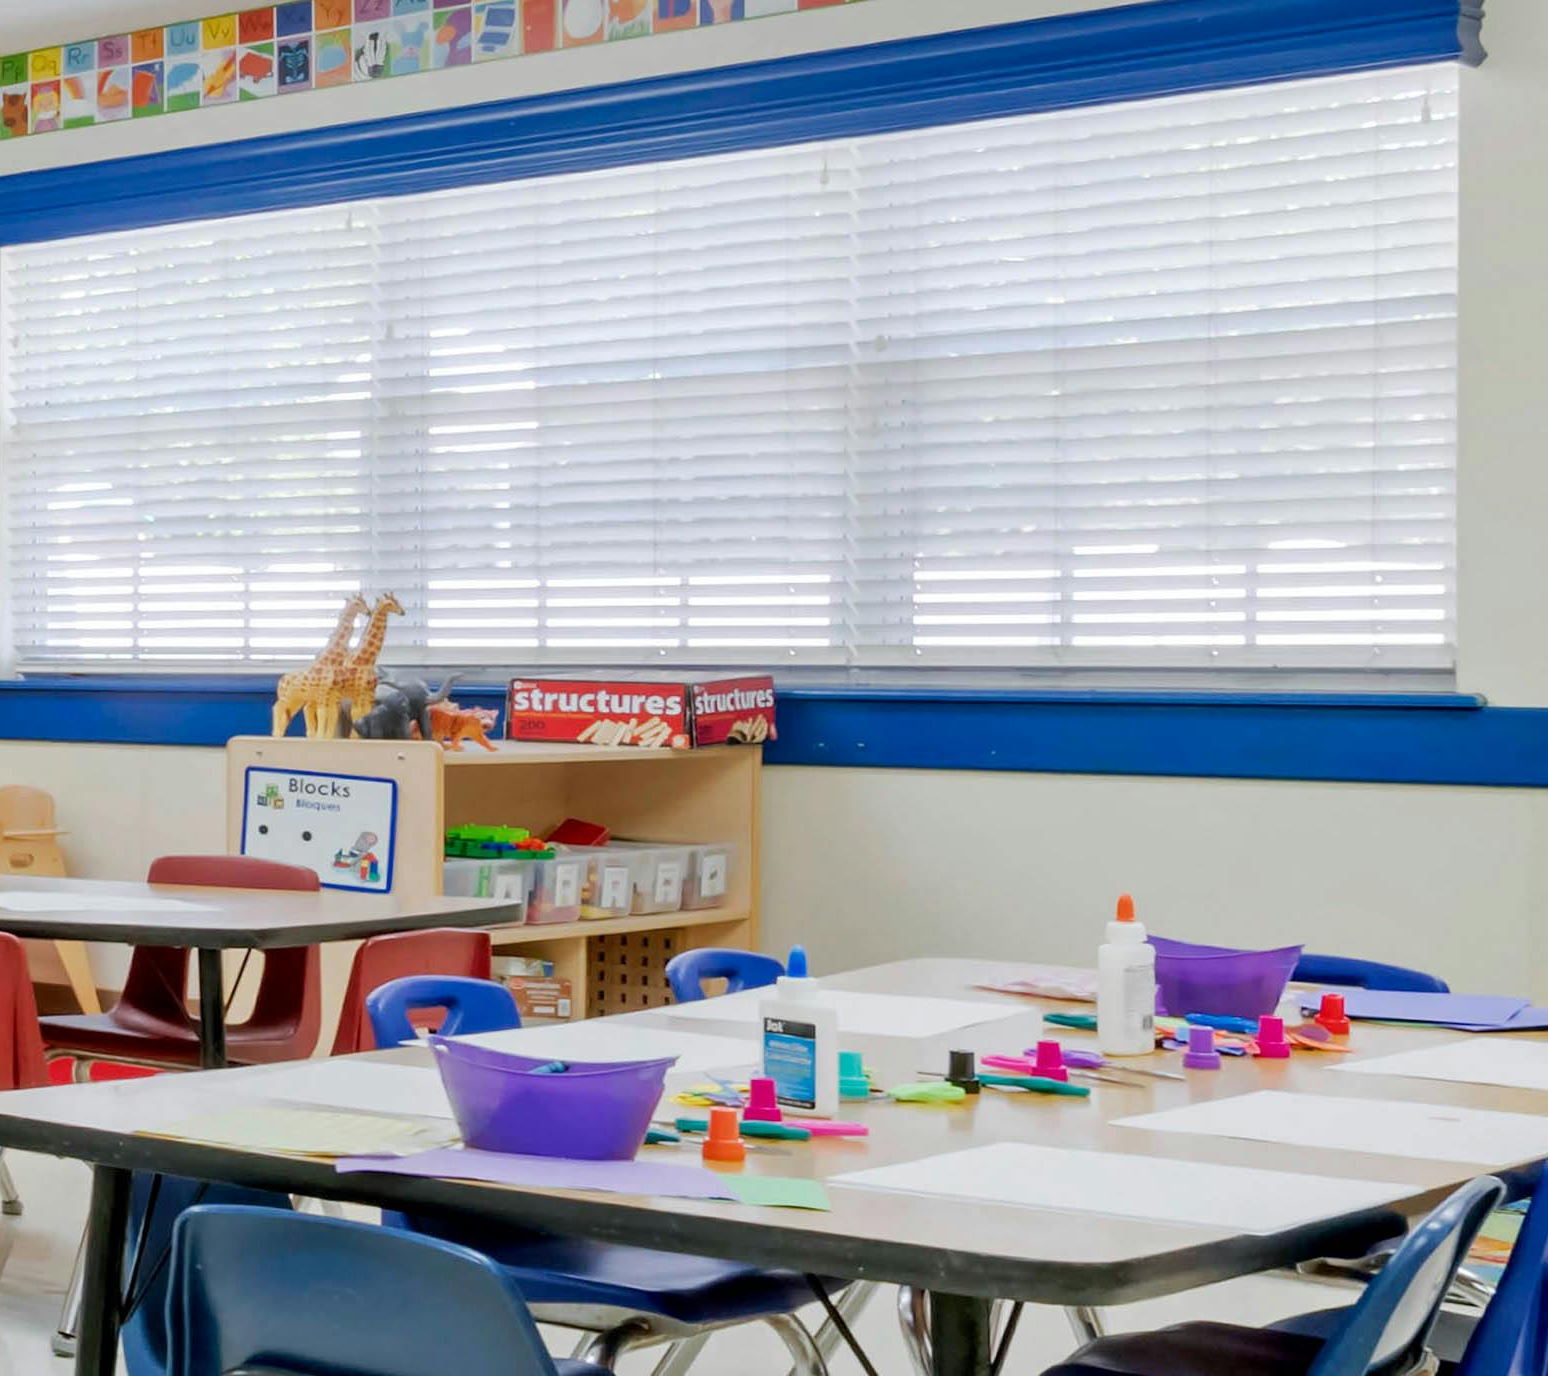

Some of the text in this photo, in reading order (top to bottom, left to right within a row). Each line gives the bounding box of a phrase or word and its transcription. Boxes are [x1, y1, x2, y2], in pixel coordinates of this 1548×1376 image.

[169, 28, 197, 48] Uu
[514, 688, 682, 716] structures
[695, 688, 775, 715] structures
[288, 777, 351, 798] Blocks
[295, 798, 341, 812] Bloques
